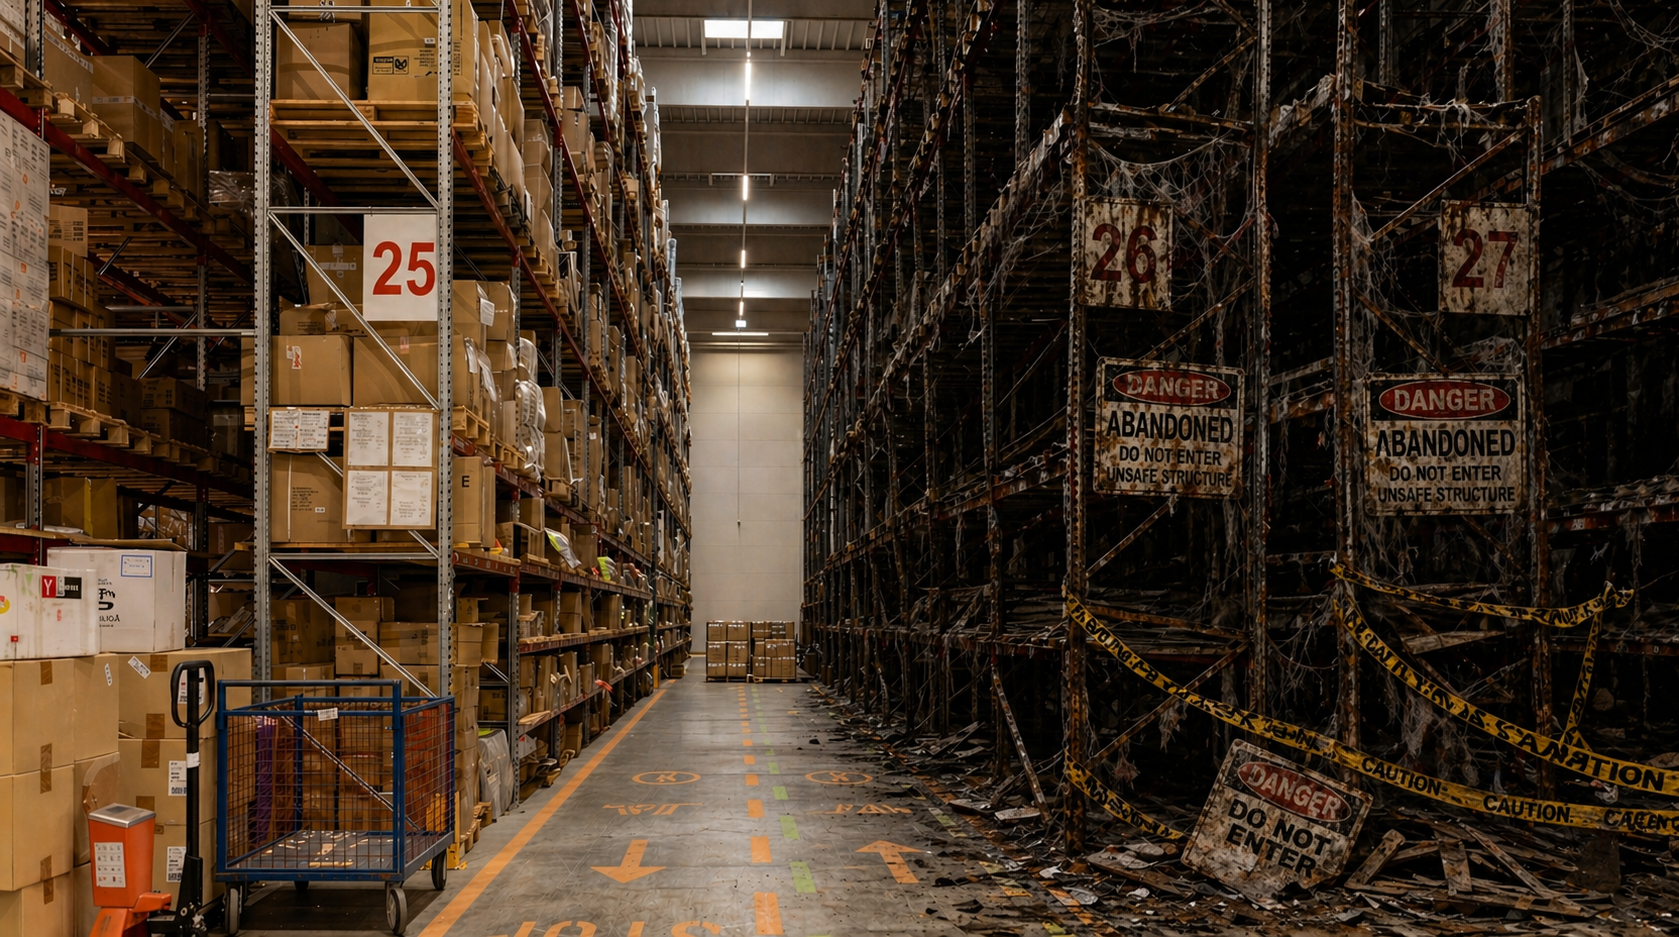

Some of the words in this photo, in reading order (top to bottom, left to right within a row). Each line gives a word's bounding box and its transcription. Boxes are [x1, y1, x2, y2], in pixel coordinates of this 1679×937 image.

[1090, 223, 1158, 284] 26
[1452, 228, 1519, 288] 27
[372, 241, 436, 296] 25
[1126, 374, 1219, 400] DANGER
[1393, 388, 1496, 411] DANGER
[1106, 410, 1234, 443] ABANDONED
[1119, 446, 1139, 461] DO
[1144, 447, 1172, 463] NOT
[1177, 450, 1222, 466] ENTER
[1375, 429, 1516, 457] ABANDONED
[461, 475, 470, 488] E
[1106, 466, 1158, 484] UNSAFE
[1161, 470, 1233, 488] STRUCTURE
[1389, 466, 1411, 482] DO
[1416, 466, 1447, 482] NOT
[1452, 465, 1502, 482] ENTER
[1377, 487, 1432, 503] UNSAFE
[1435, 487, 1516, 503] STRUCTURE
[1247, 764, 1342, 820] DANGER
[1227, 798, 1267, 829] DO
[1272, 818, 1332, 856] NOT
[1225, 823, 1318, 879] ENTER
